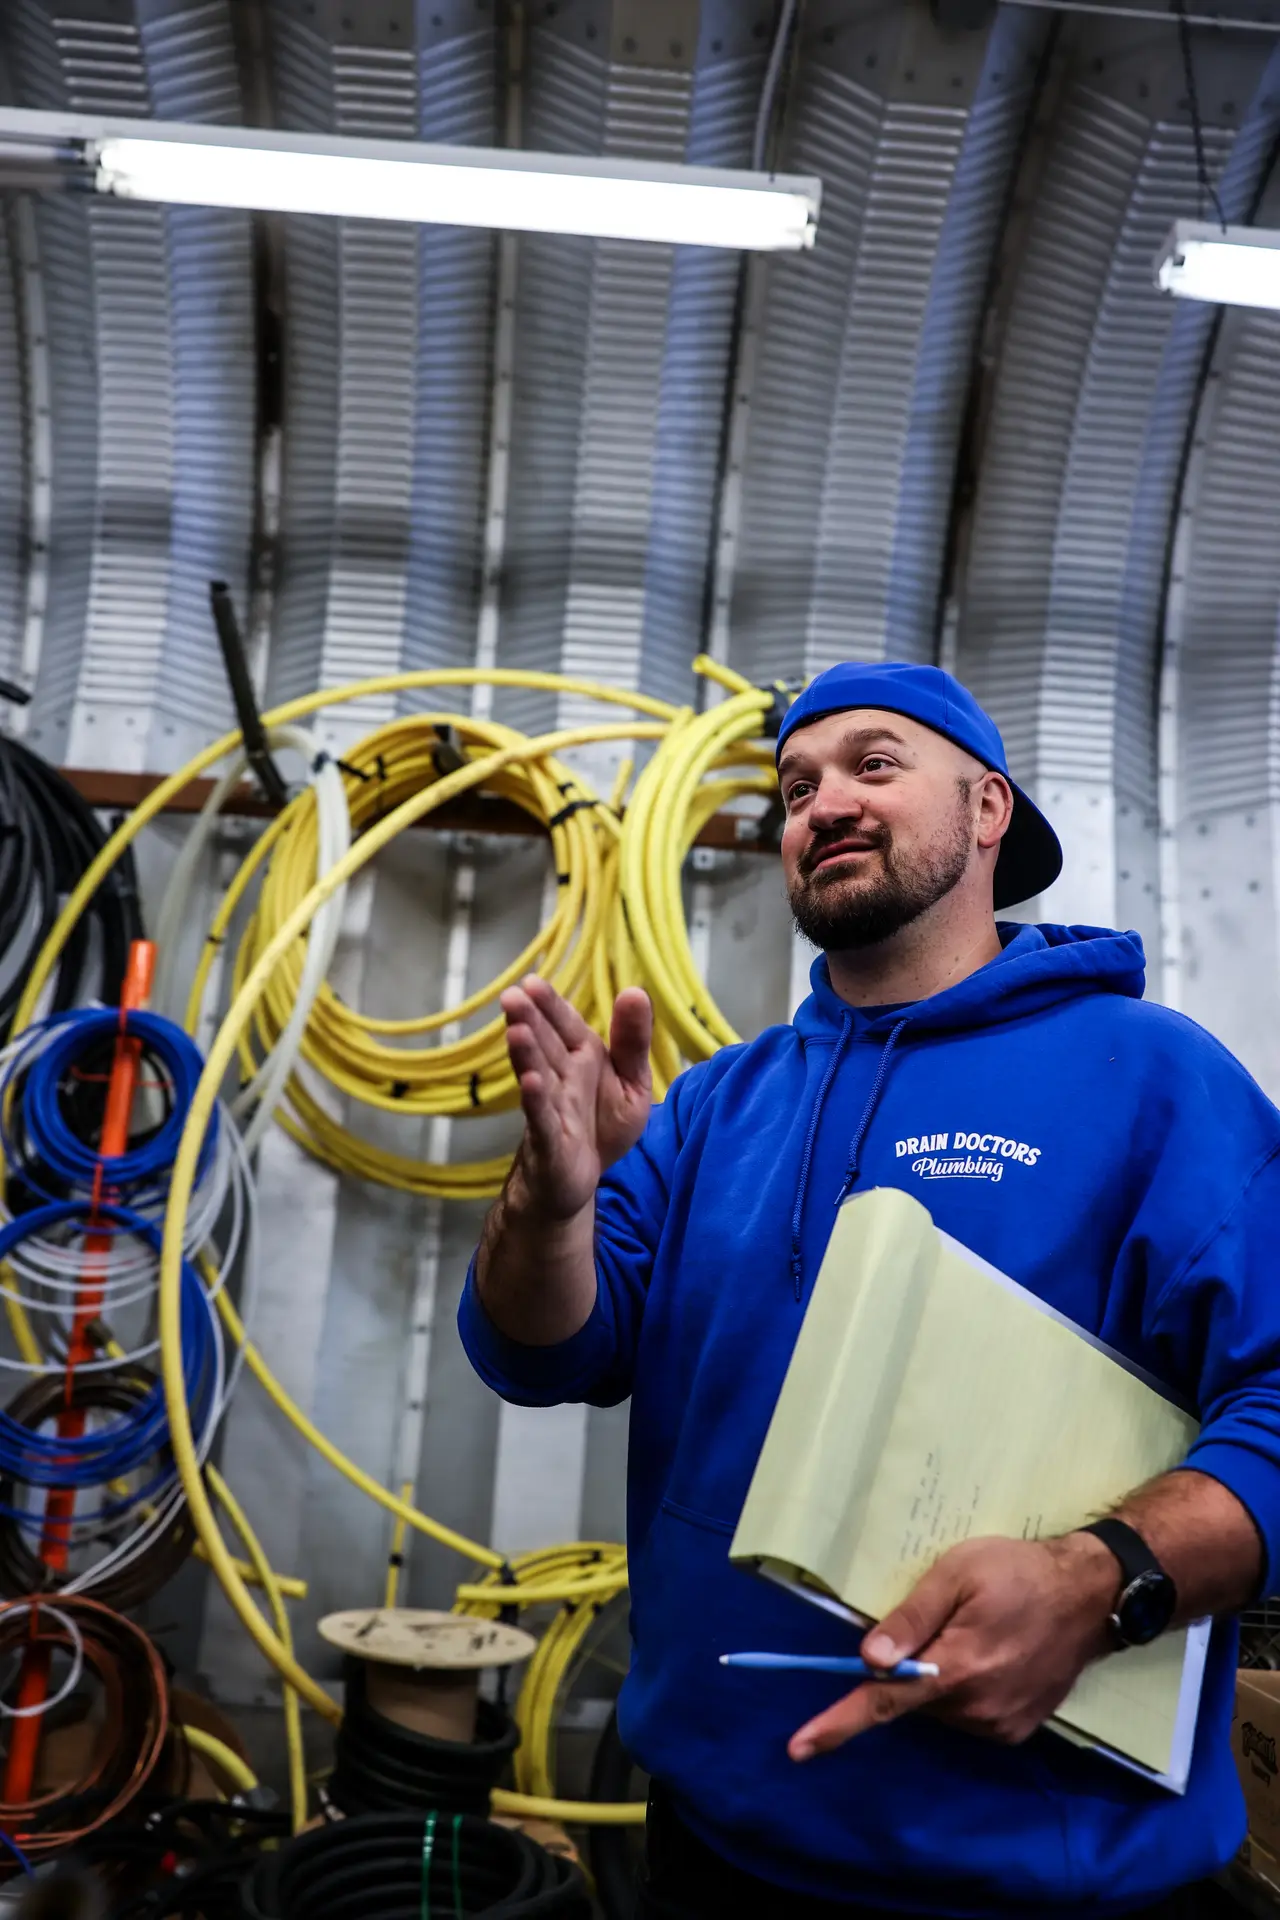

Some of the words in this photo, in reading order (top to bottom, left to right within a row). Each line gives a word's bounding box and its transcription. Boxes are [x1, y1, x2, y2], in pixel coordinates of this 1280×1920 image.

[895, 1132, 949, 1158] DRAIN
[953, 1132, 1041, 1166] DOCTORS
[911, 1155, 1004, 1182] Plumbing
